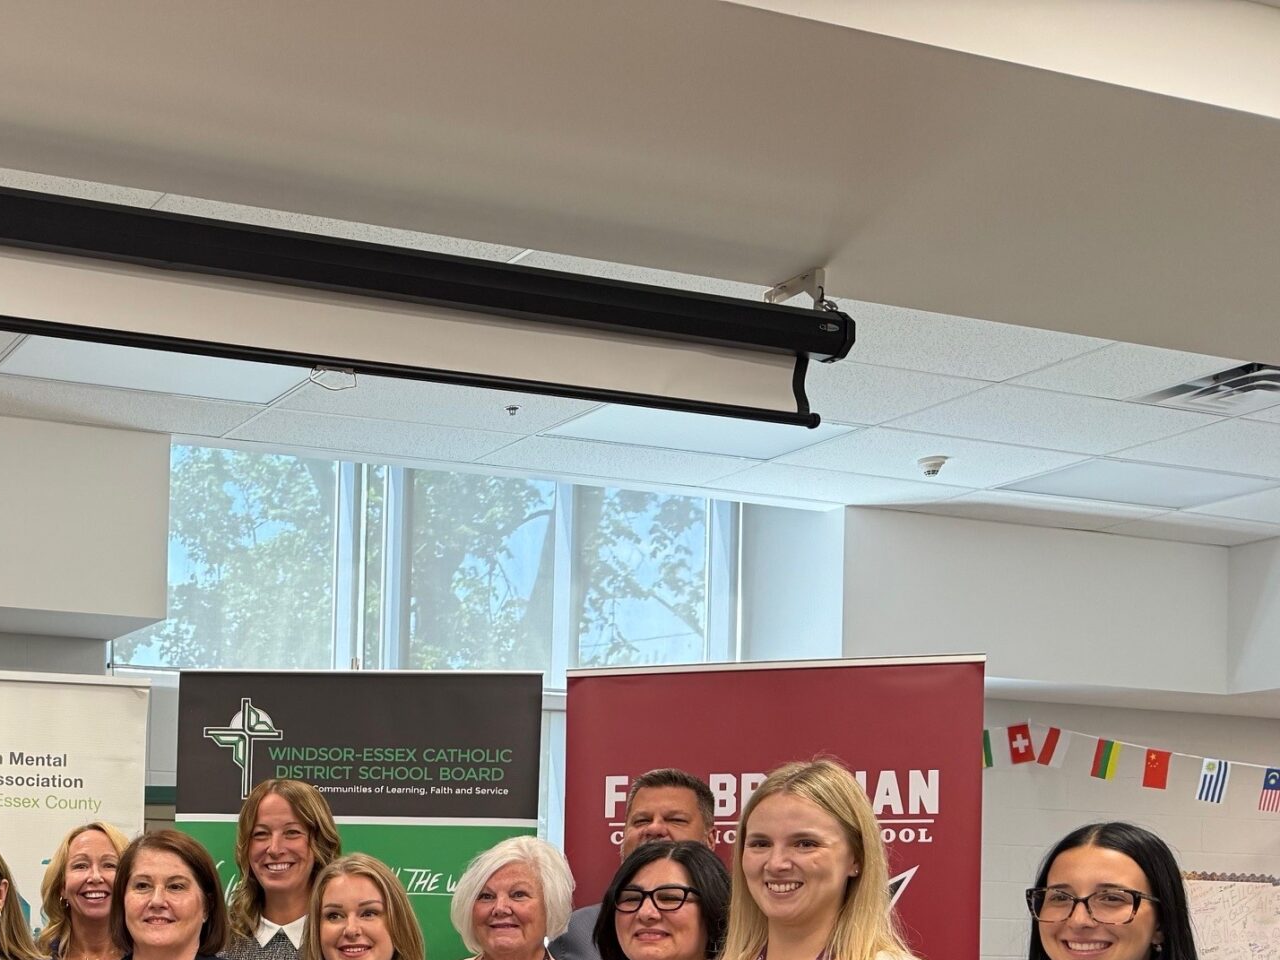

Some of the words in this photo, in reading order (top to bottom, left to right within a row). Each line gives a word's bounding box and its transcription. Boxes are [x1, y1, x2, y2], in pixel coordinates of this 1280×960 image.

[9, 751, 67, 767] Mental
[268, 747, 417, 762] WINDSOR-ESSEX
[422, 748, 513, 763] CATHOLIC
[275, 765, 353, 780] DISTRICT
[358, 766, 433, 781] SCHOOL
[439, 767, 504, 781] BOARD
[313, 784, 372, 794] Communities
[374, 785, 384, 794] of
[386, 785, 428, 796] Learning,
[430, 786, 453, 795] Faith
[455, 786, 473, 795] and
[475, 786, 509, 795] Service
[45, 795, 102, 814] County
[403, 868, 444, 892] THE
